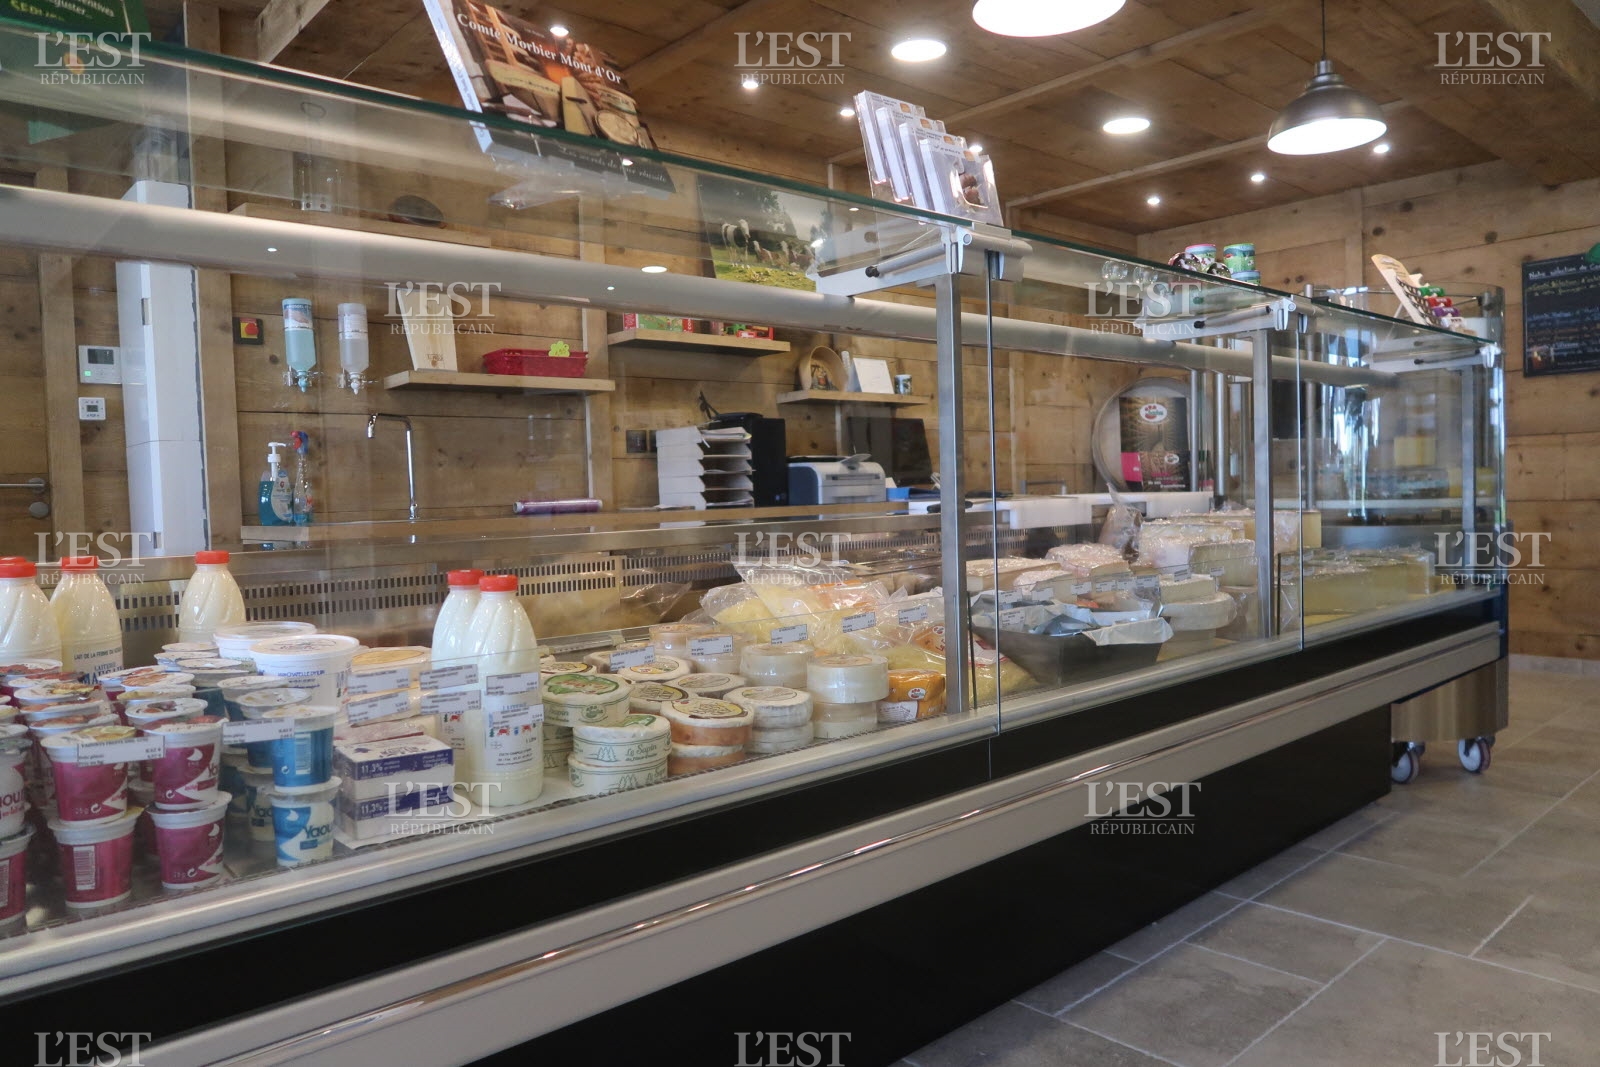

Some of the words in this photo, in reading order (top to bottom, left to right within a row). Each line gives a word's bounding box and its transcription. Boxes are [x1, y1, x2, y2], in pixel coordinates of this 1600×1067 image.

[505, 32, 557, 61] Morbier
[560, 52, 593, 74] Mont
[595, 66, 622, 85] d'Or
